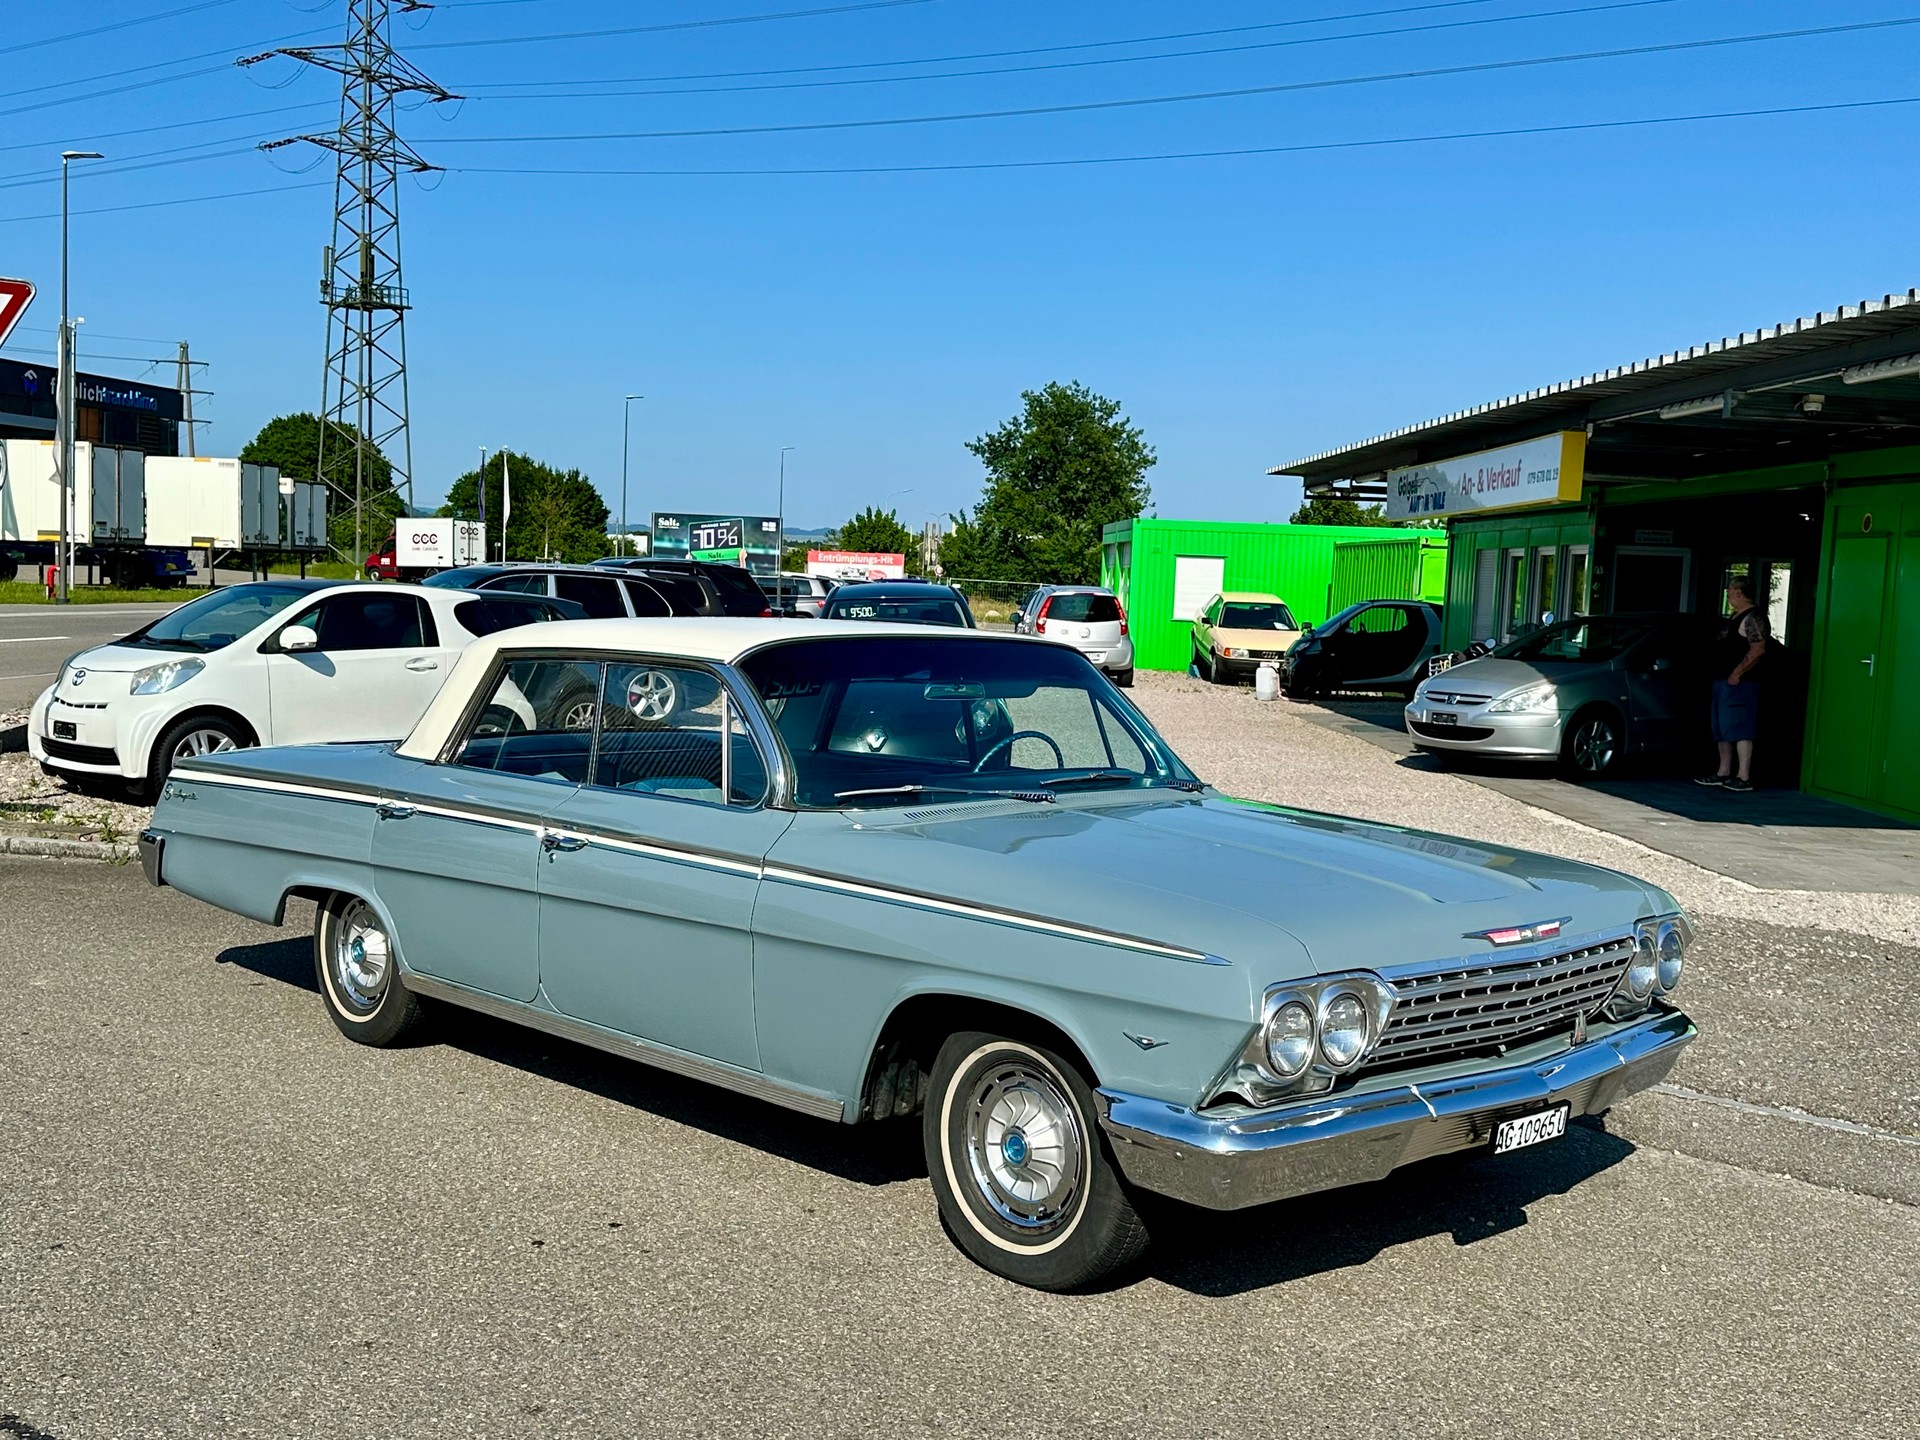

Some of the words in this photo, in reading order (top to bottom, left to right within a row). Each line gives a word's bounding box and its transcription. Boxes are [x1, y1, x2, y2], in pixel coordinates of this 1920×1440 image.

[1477, 468, 1484, 493] &
[1486, 458, 1522, 491] Verkauf
[412, 533, 438, 545] CCC
